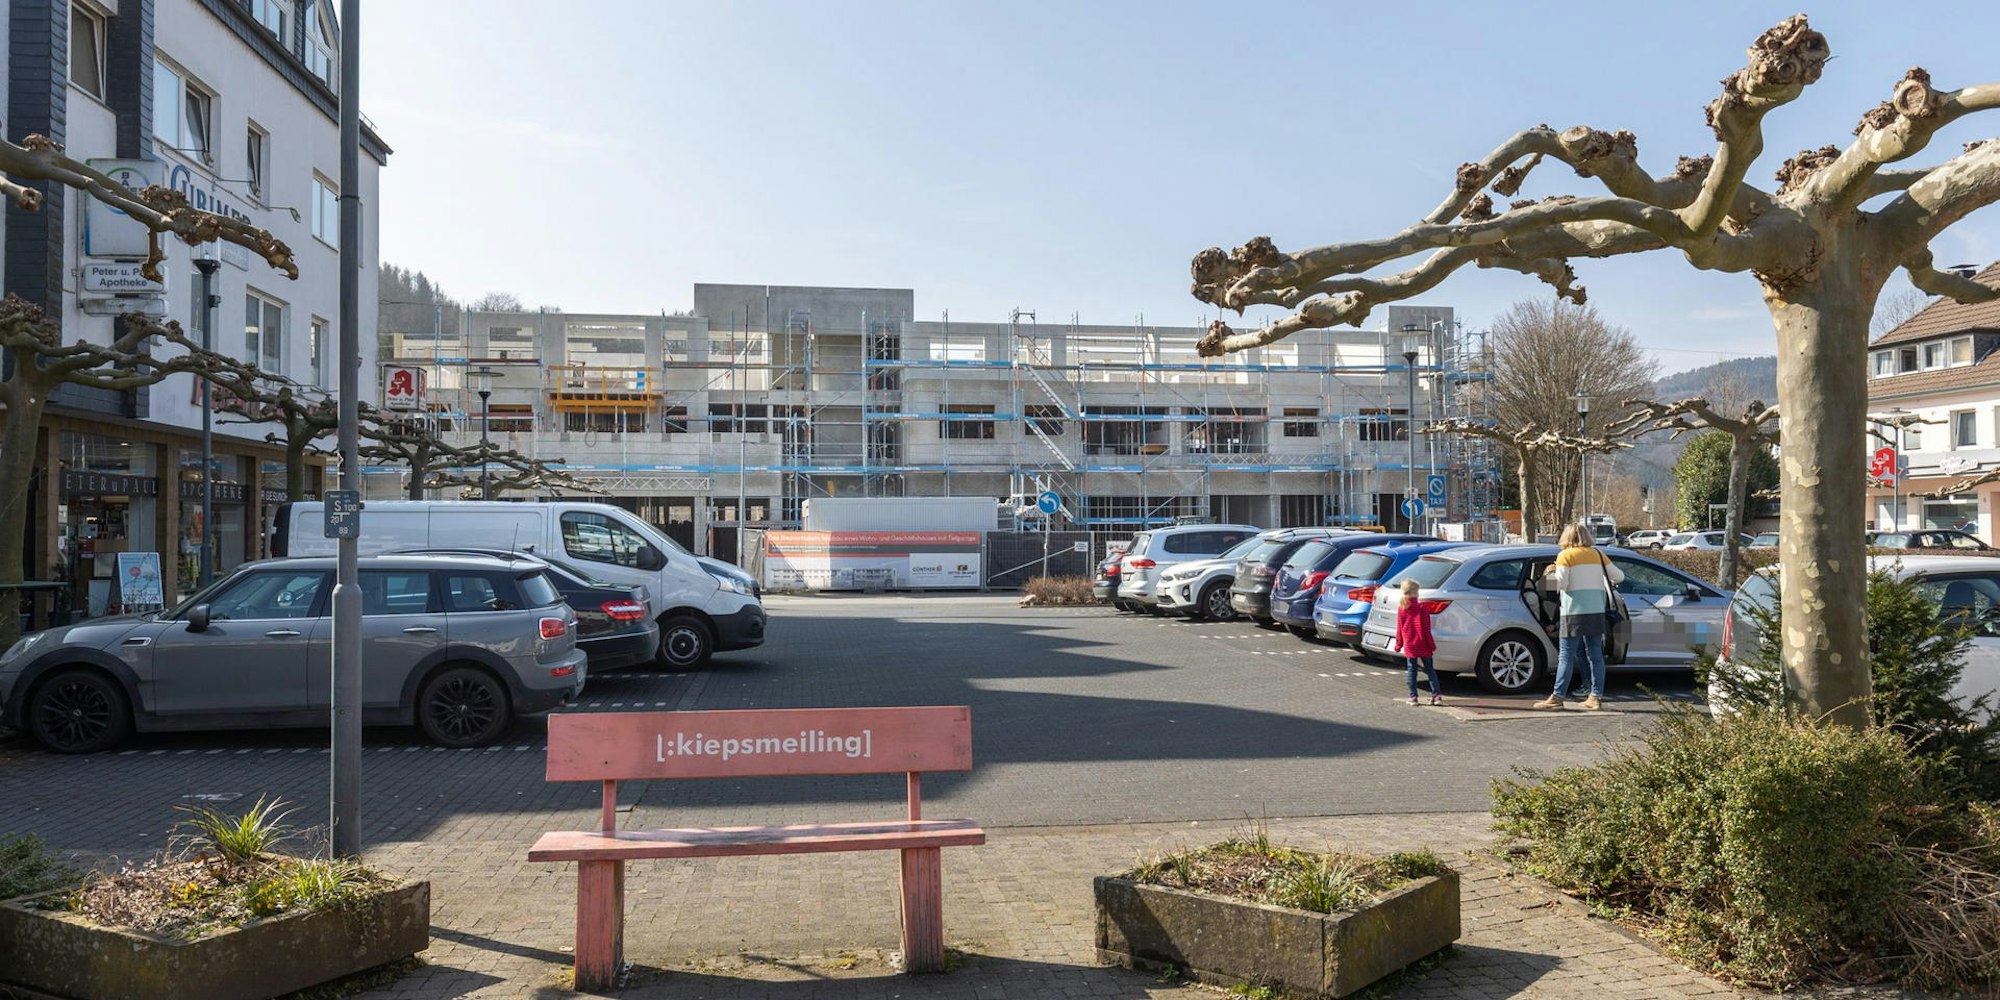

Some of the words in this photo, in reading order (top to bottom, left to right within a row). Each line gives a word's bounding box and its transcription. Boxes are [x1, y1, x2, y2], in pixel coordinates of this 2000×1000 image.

[92, 267, 117, 275] Peter
[100, 278, 147, 288] Apotheke
[65, 473, 107, 492] ETER
[1430, 497, 1445, 505] TAXI
[344, 503, 357, 512] 100
[656, 729, 871, 762] [:kiepsmeiling]
